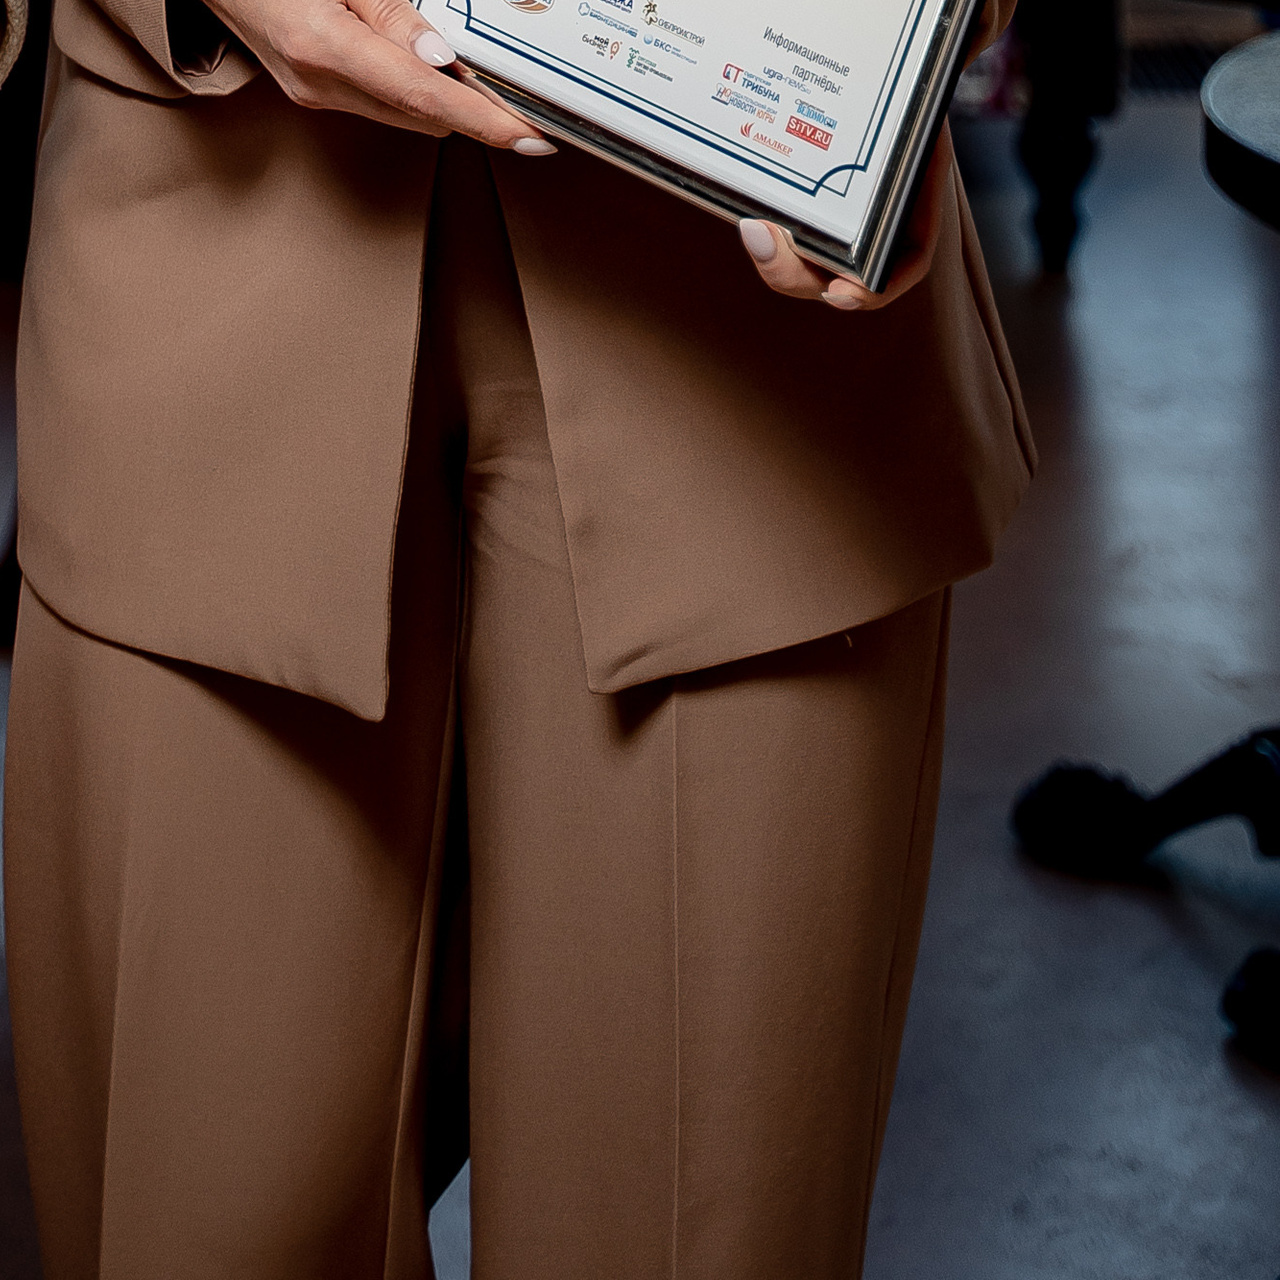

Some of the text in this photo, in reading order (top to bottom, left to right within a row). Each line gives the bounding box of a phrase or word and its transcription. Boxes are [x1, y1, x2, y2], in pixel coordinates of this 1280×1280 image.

[653, 38, 672, 53] БКС
[763, 26, 850, 77] Информационные
[741, 77, 780, 104] ТРИБУНА
[791, 64, 843, 96] партнёры:
[728, 96, 776, 124] НОВОСТИ ЮГРЫ
[788, 117, 832, 145] SiTV.RU
